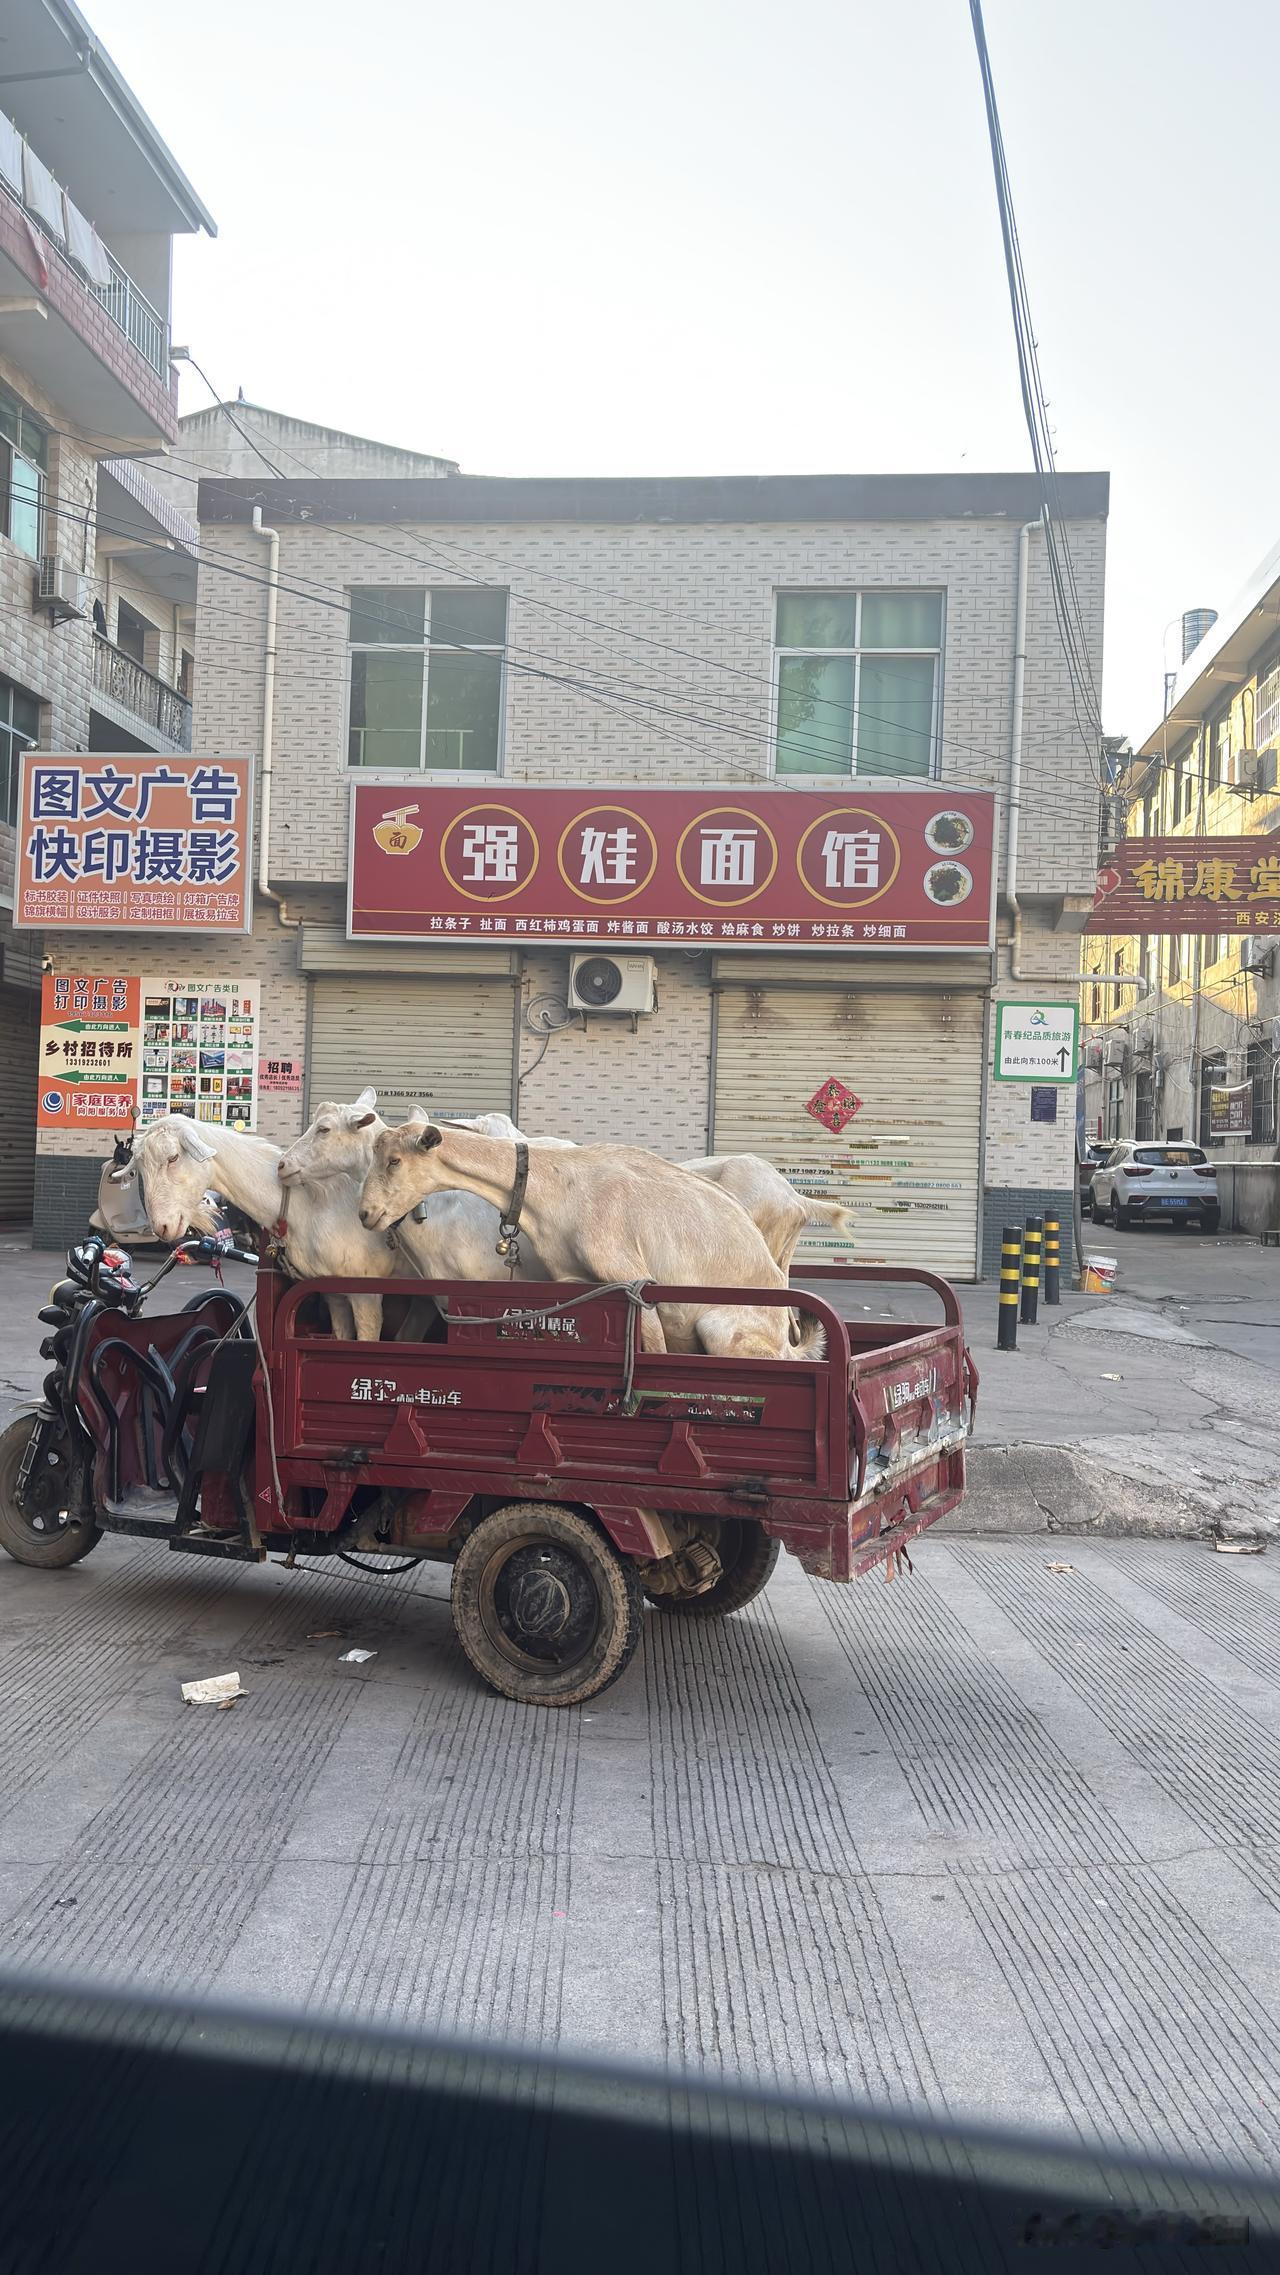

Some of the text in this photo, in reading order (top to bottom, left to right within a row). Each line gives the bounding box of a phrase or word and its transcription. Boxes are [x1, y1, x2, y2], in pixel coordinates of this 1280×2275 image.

[31, 766, 240, 822] 图文广告
[389, 832, 407, 849] 面
[29, 827, 240, 883] 快印摄影
[462, 824, 880, 889] 强娃面馆
[24, 890, 241, 906] 标书胶装 证件快照 写真喷绘 灯箱广告牌
[24, 905, 239, 921] 锦旗横幅 设计服务 定制相框 展板易拉宝
[430, 916, 907, 938] 拉条子 扯面 西红柿鸡蛋面 炸酱面 酸汤水饺 烩麻食 炒饼 炒拉条 炒细面
[55, 977, 128, 994] 图文广告
[187, 984, 239, 993] 图文广告类目
[54, 995, 127, 1011] 打印摄影
[1004, 1030, 1071, 1042] 青春纪品质旅游
[45, 1040, 133, 1058] 乡村招待所
[65, 1058, 111, 1066] 13319232601
[267, 1061, 293, 1074] 招聘
[1004, 1056, 1059, 1066] 由此向东100米
[72, 1093, 133, 1108] 家庭医养
